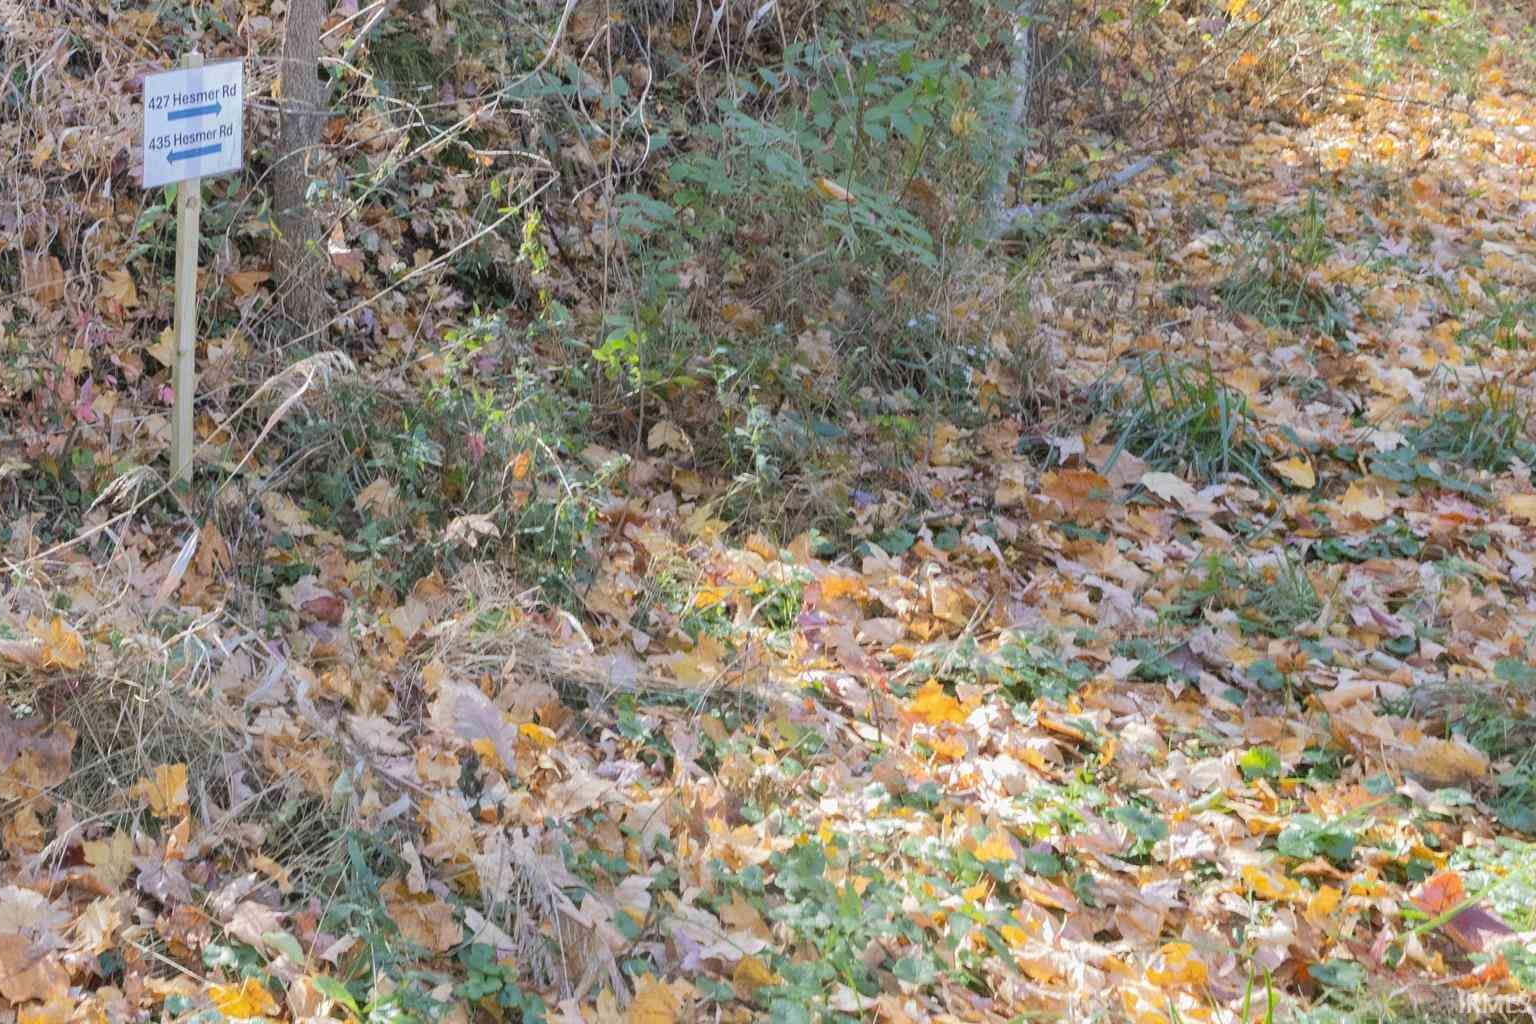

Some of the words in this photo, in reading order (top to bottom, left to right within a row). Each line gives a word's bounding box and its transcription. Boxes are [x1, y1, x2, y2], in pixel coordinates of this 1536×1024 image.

[148, 95, 170, 111] 427
[222, 83, 237, 99] Rd
[148, 135, 171, 151] 435
[219, 123, 233, 138] Rd
